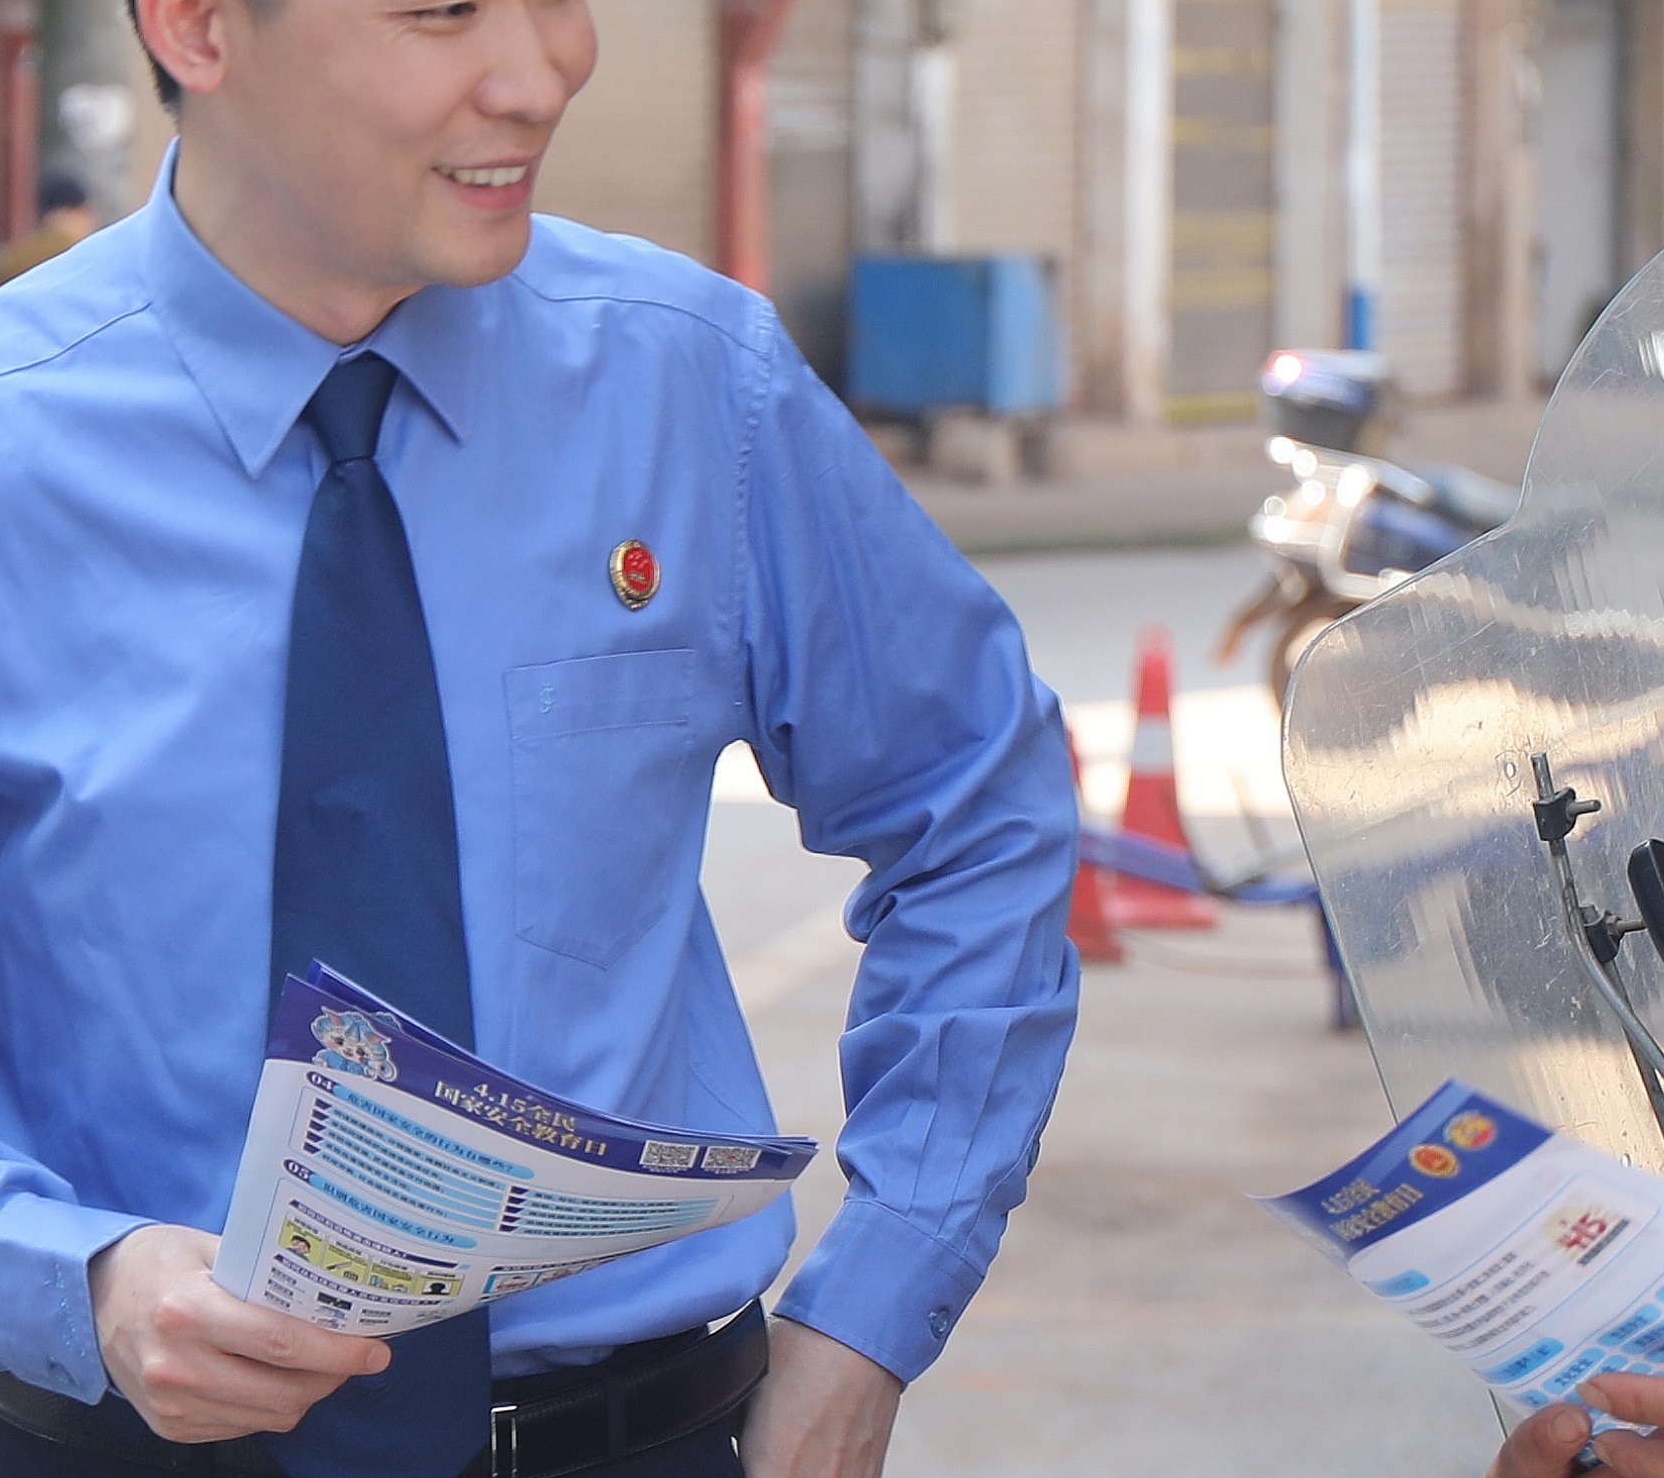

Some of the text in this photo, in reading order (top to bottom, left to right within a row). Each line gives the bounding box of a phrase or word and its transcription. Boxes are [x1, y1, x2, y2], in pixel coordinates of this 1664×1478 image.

[310, 1074, 333, 1092] 04
[435, 1080, 608, 1156] 国家安全教育日
[473, 1083, 577, 1131] 4.15全民
[288, 1162, 310, 1179] 05
